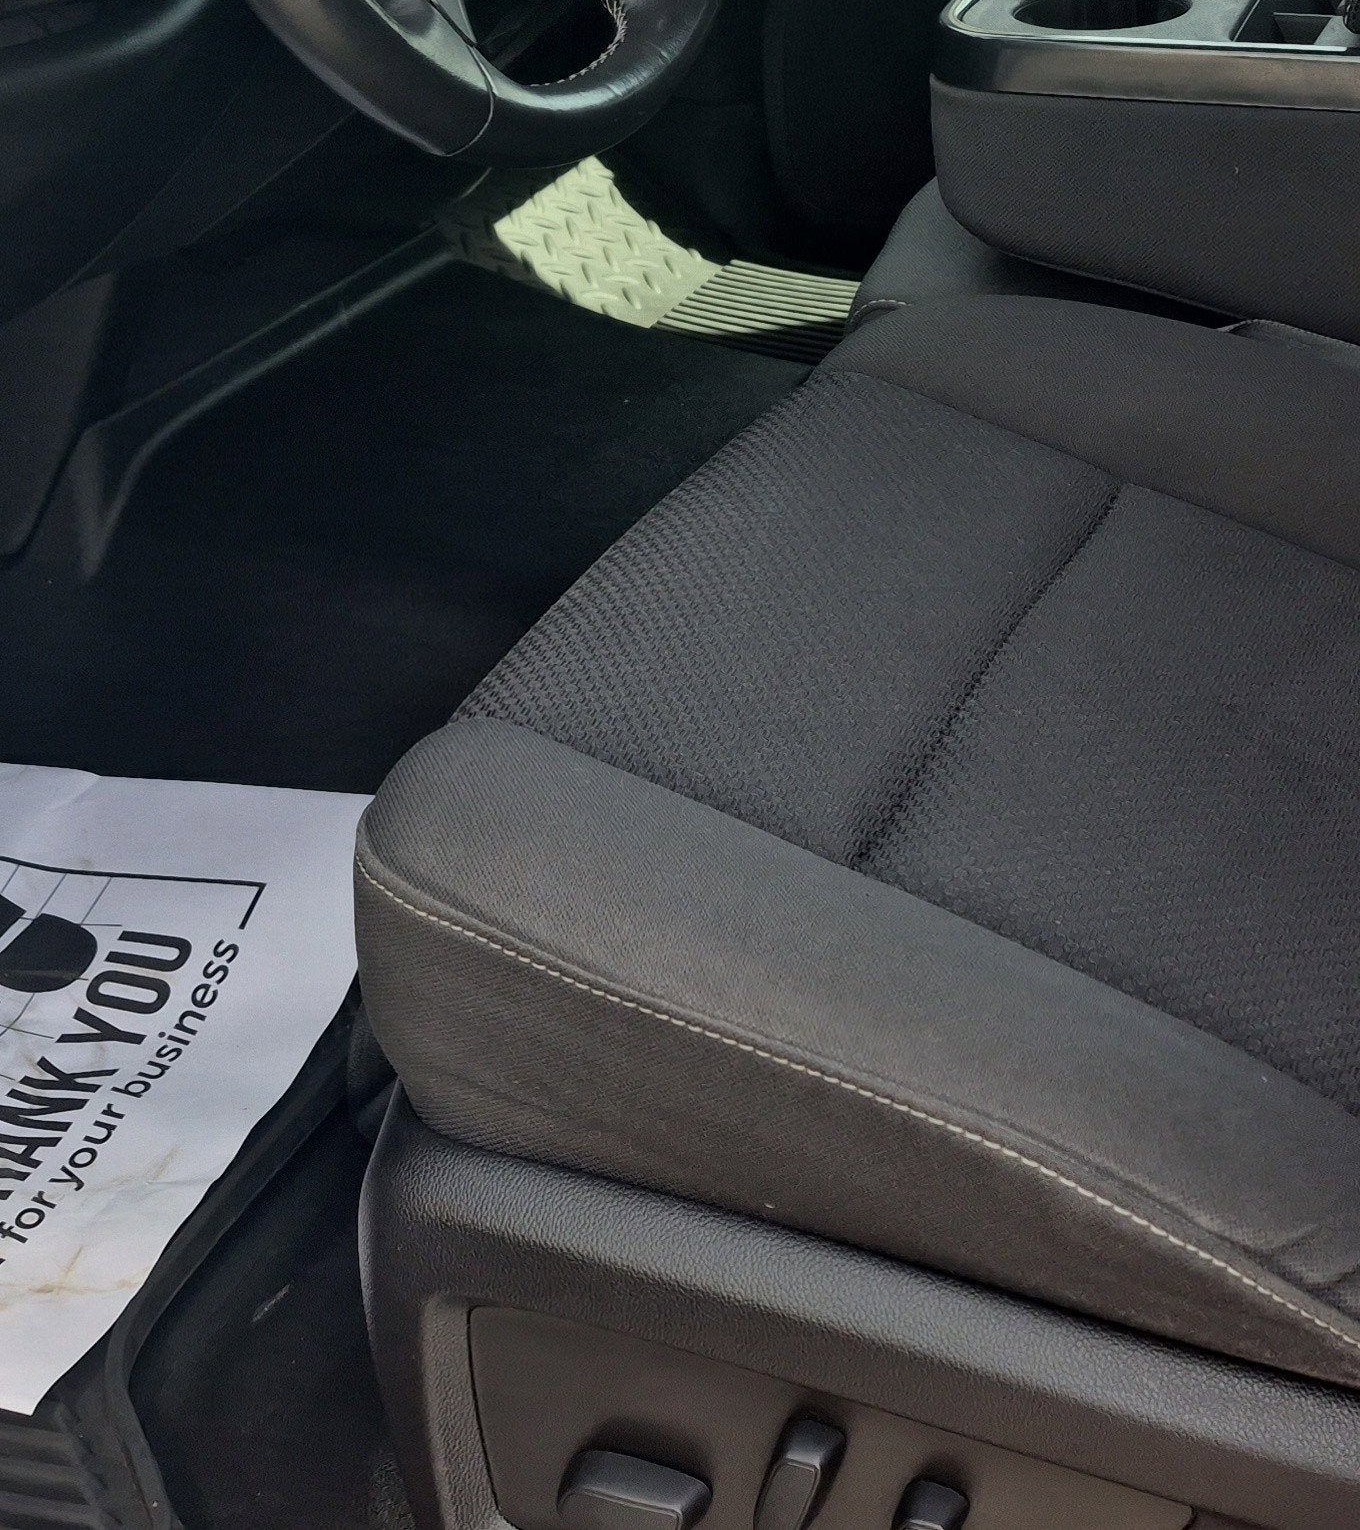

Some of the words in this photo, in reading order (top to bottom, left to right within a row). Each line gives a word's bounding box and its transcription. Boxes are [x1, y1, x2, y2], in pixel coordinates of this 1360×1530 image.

[48, 1103, 127, 1192] your
[110, 938, 240, 1099] business
[55, 930, 193, 1046] YOU
